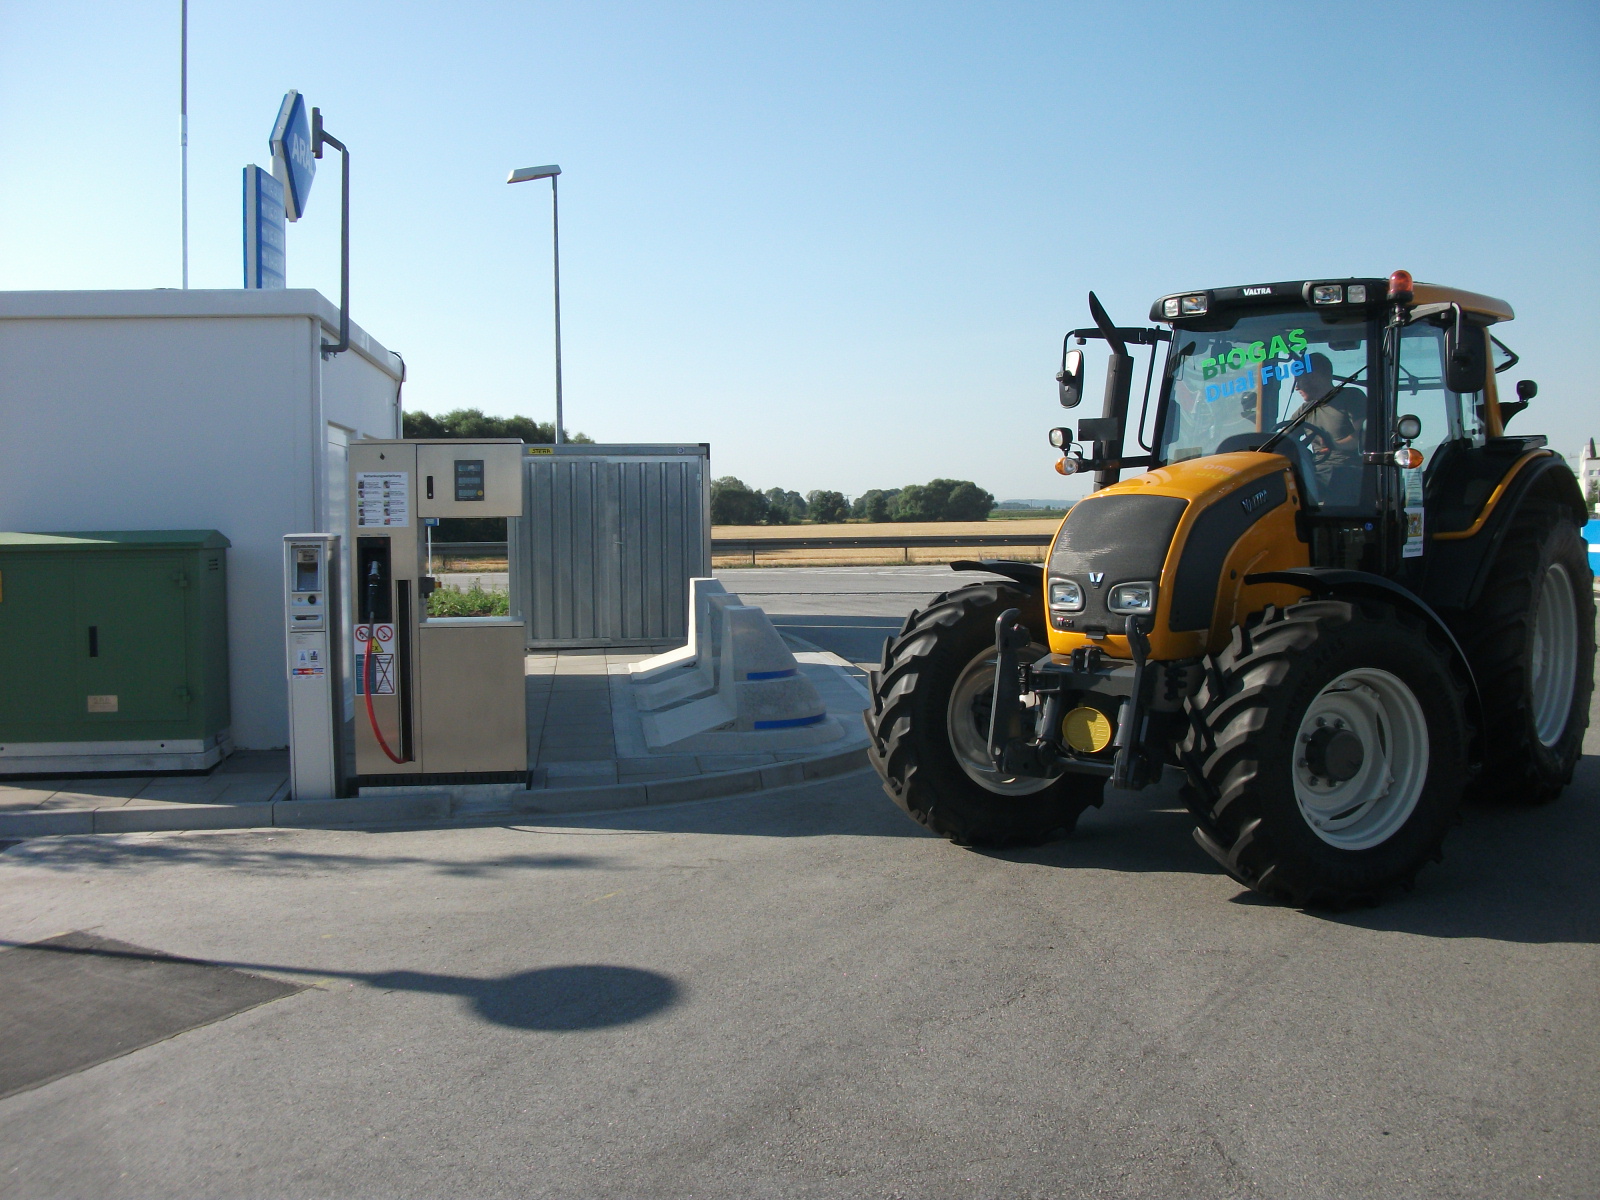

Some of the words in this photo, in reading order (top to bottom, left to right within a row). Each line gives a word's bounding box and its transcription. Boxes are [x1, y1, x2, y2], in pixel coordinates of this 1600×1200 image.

[1242, 286, 1272, 297] VALTRA
[1201, 328, 1309, 381] BIOGAS
[1204, 369, 1256, 403] Dual
[1261, 353, 1314, 386] Fuel
